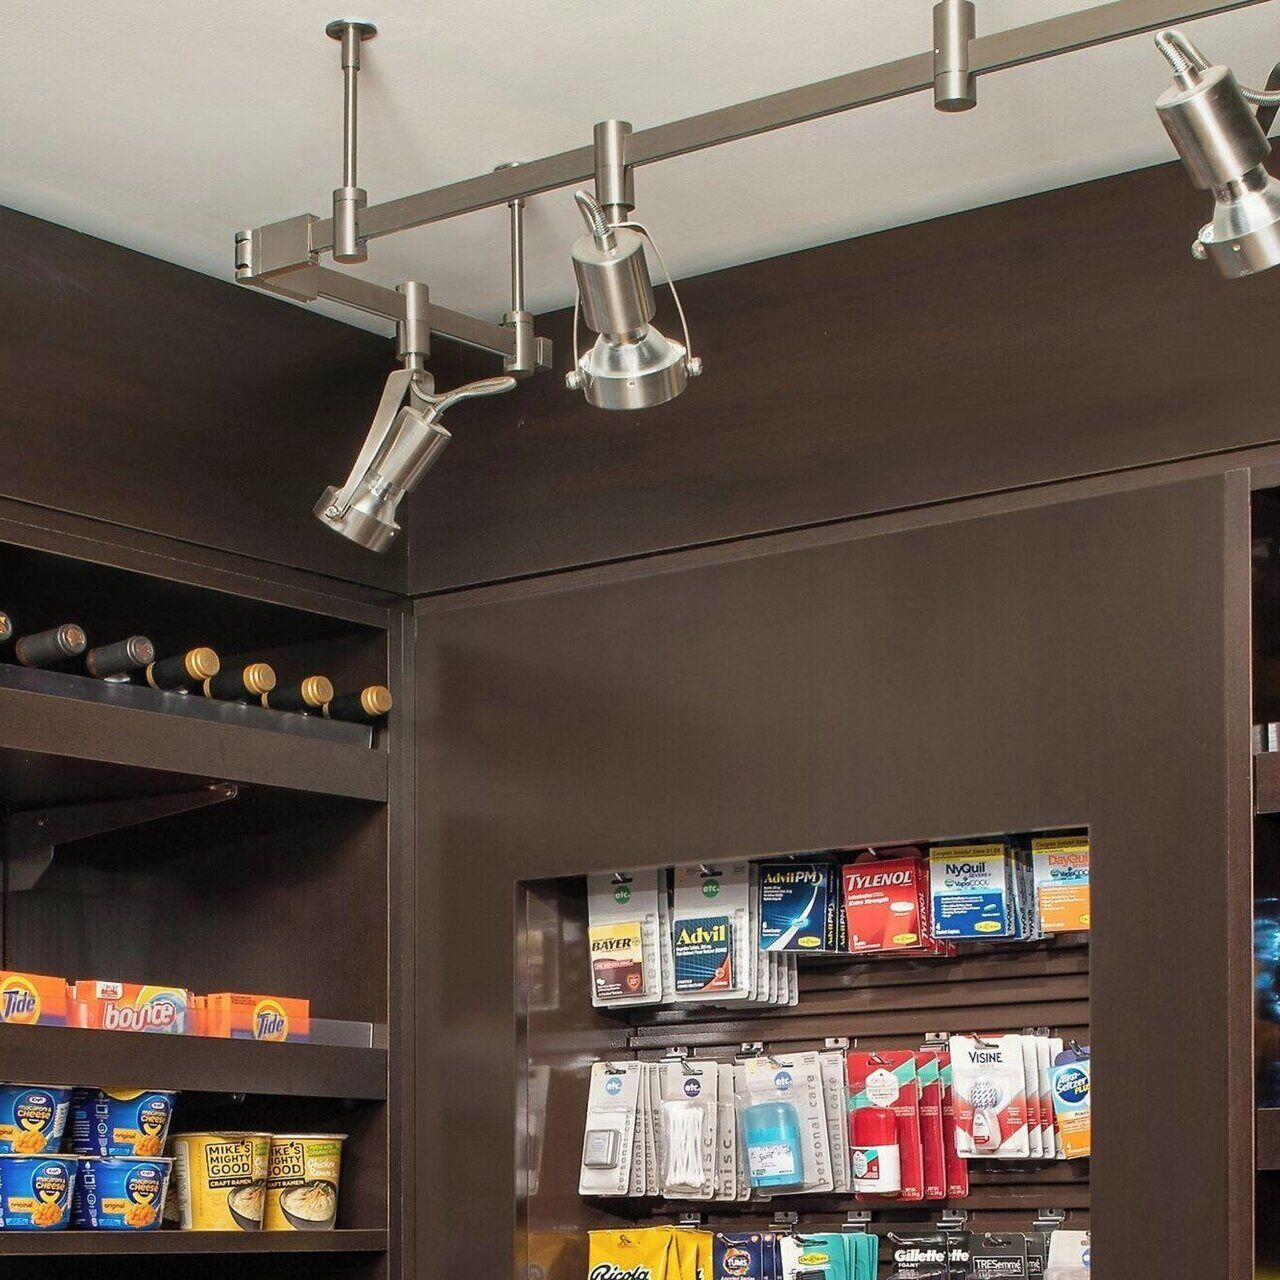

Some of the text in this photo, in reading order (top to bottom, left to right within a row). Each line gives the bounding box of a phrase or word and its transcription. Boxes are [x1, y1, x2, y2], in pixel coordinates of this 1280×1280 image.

[946, 863, 986, 875] NyQuil
[763, 870, 818, 884] Advil PM
[846, 871, 912, 891] TYLENOL
[677, 925, 726, 945] Advil
[592, 938, 632, 951] BAYER
[3, 989, 36, 1019] Tide
[104, 1001, 172, 1029] bounce
[257, 1011, 285, 1038] Tide
[968, 1051, 1003, 1064] VISINE
[807, 1074, 827, 1185] personal care
[209, 1143, 251, 1156] MIKE'S
[210, 1154, 251, 1164] MIGHTY
[211, 1163, 250, 1175] GOOD
[232, 1178, 252, 1186] RAMEN
[282, 1178, 304, 1186] RAMEN
[104, 1202, 126, 1210] original
[894, 1249, 945, 1263] Gillette
[727, 1258, 748, 1268] TUMS
[975, 1258, 1021, 1271] TRESemmé
